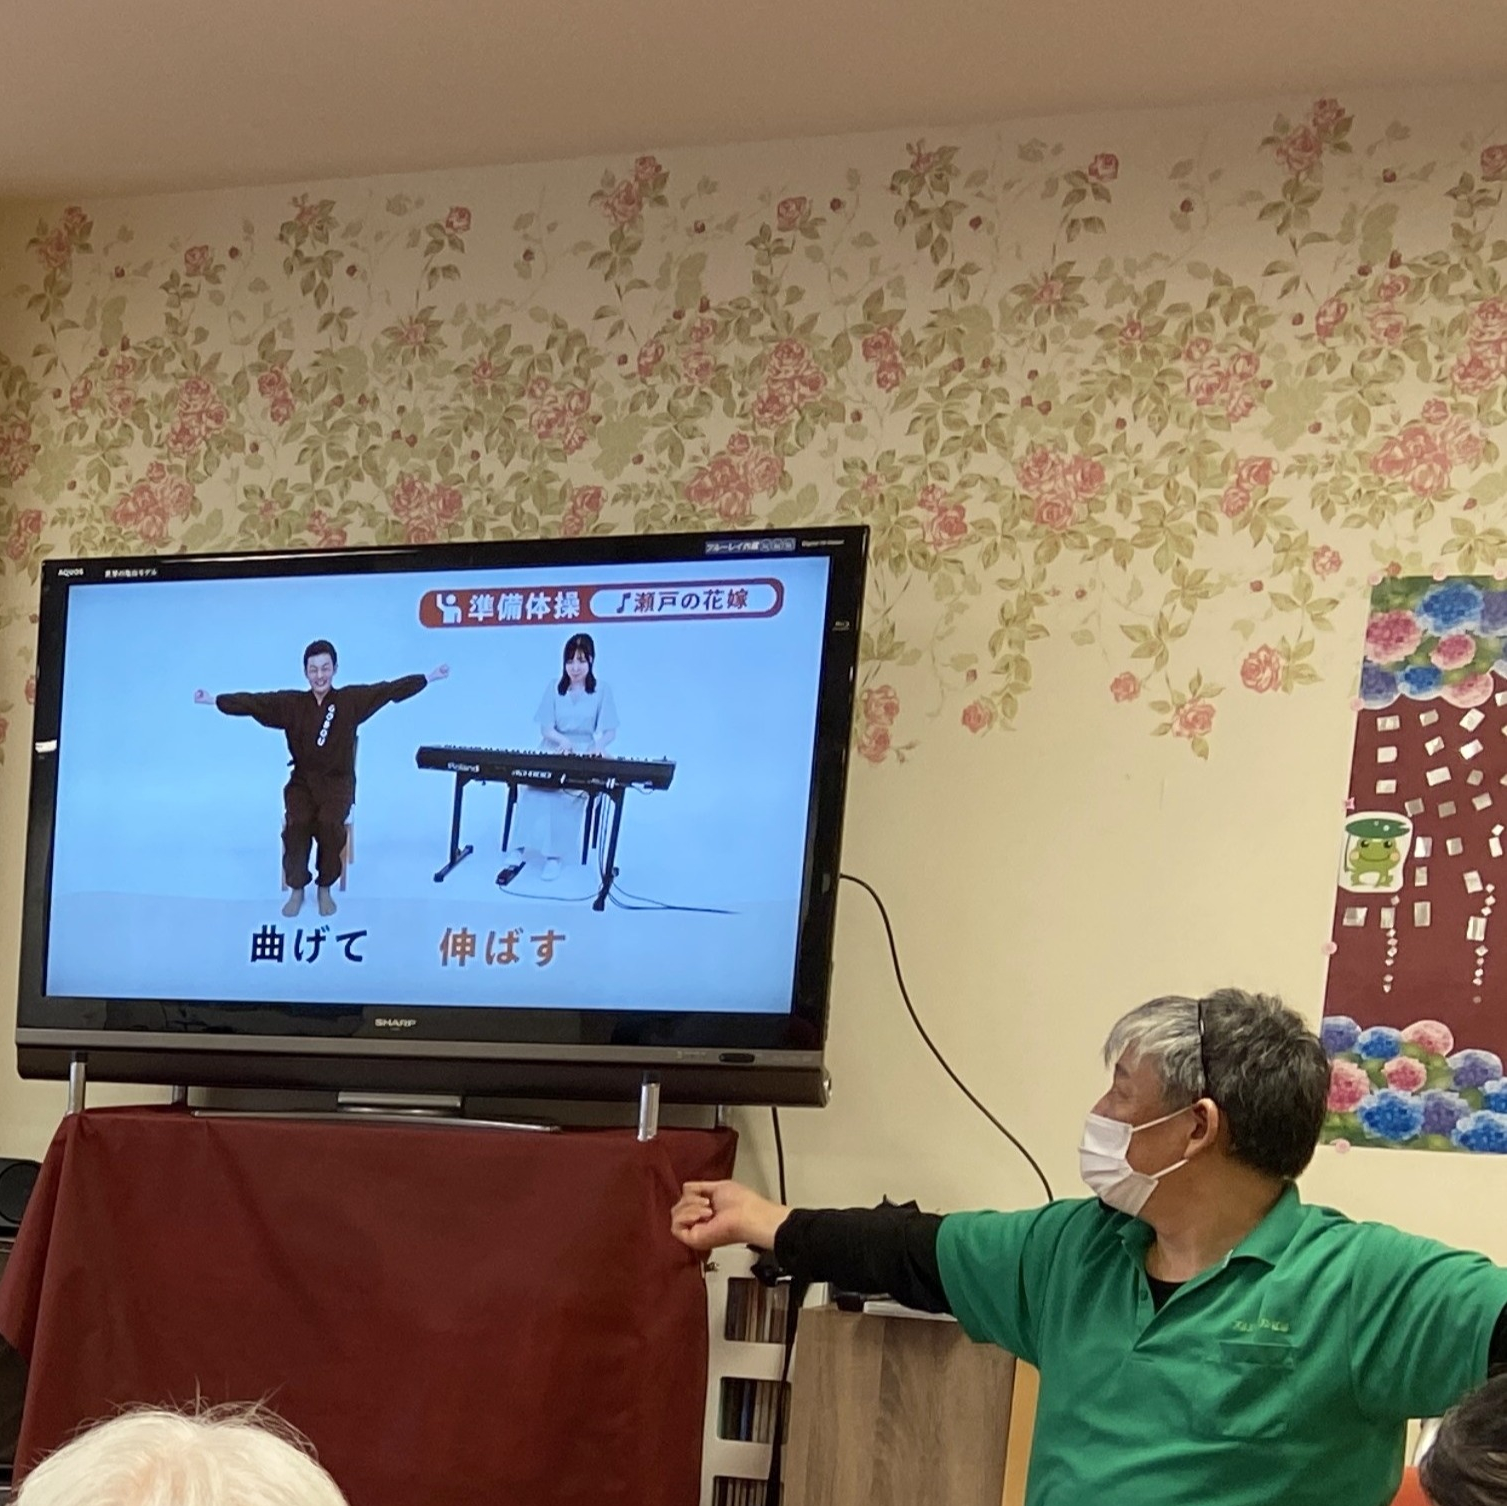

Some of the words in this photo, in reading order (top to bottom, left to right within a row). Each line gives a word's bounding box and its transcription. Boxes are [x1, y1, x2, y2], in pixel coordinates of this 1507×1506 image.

[57, 568, 84, 577] AQUOS
[468, 590, 580, 622] 準備体操
[634, 588, 749, 614] 瀬戸の花嫁
[447, 762, 480, 773] Roland
[250, 924, 368, 963] 曲げて
[439, 926, 567, 967] 伸ばす
[374, 1017, 417, 1028] SHARP
